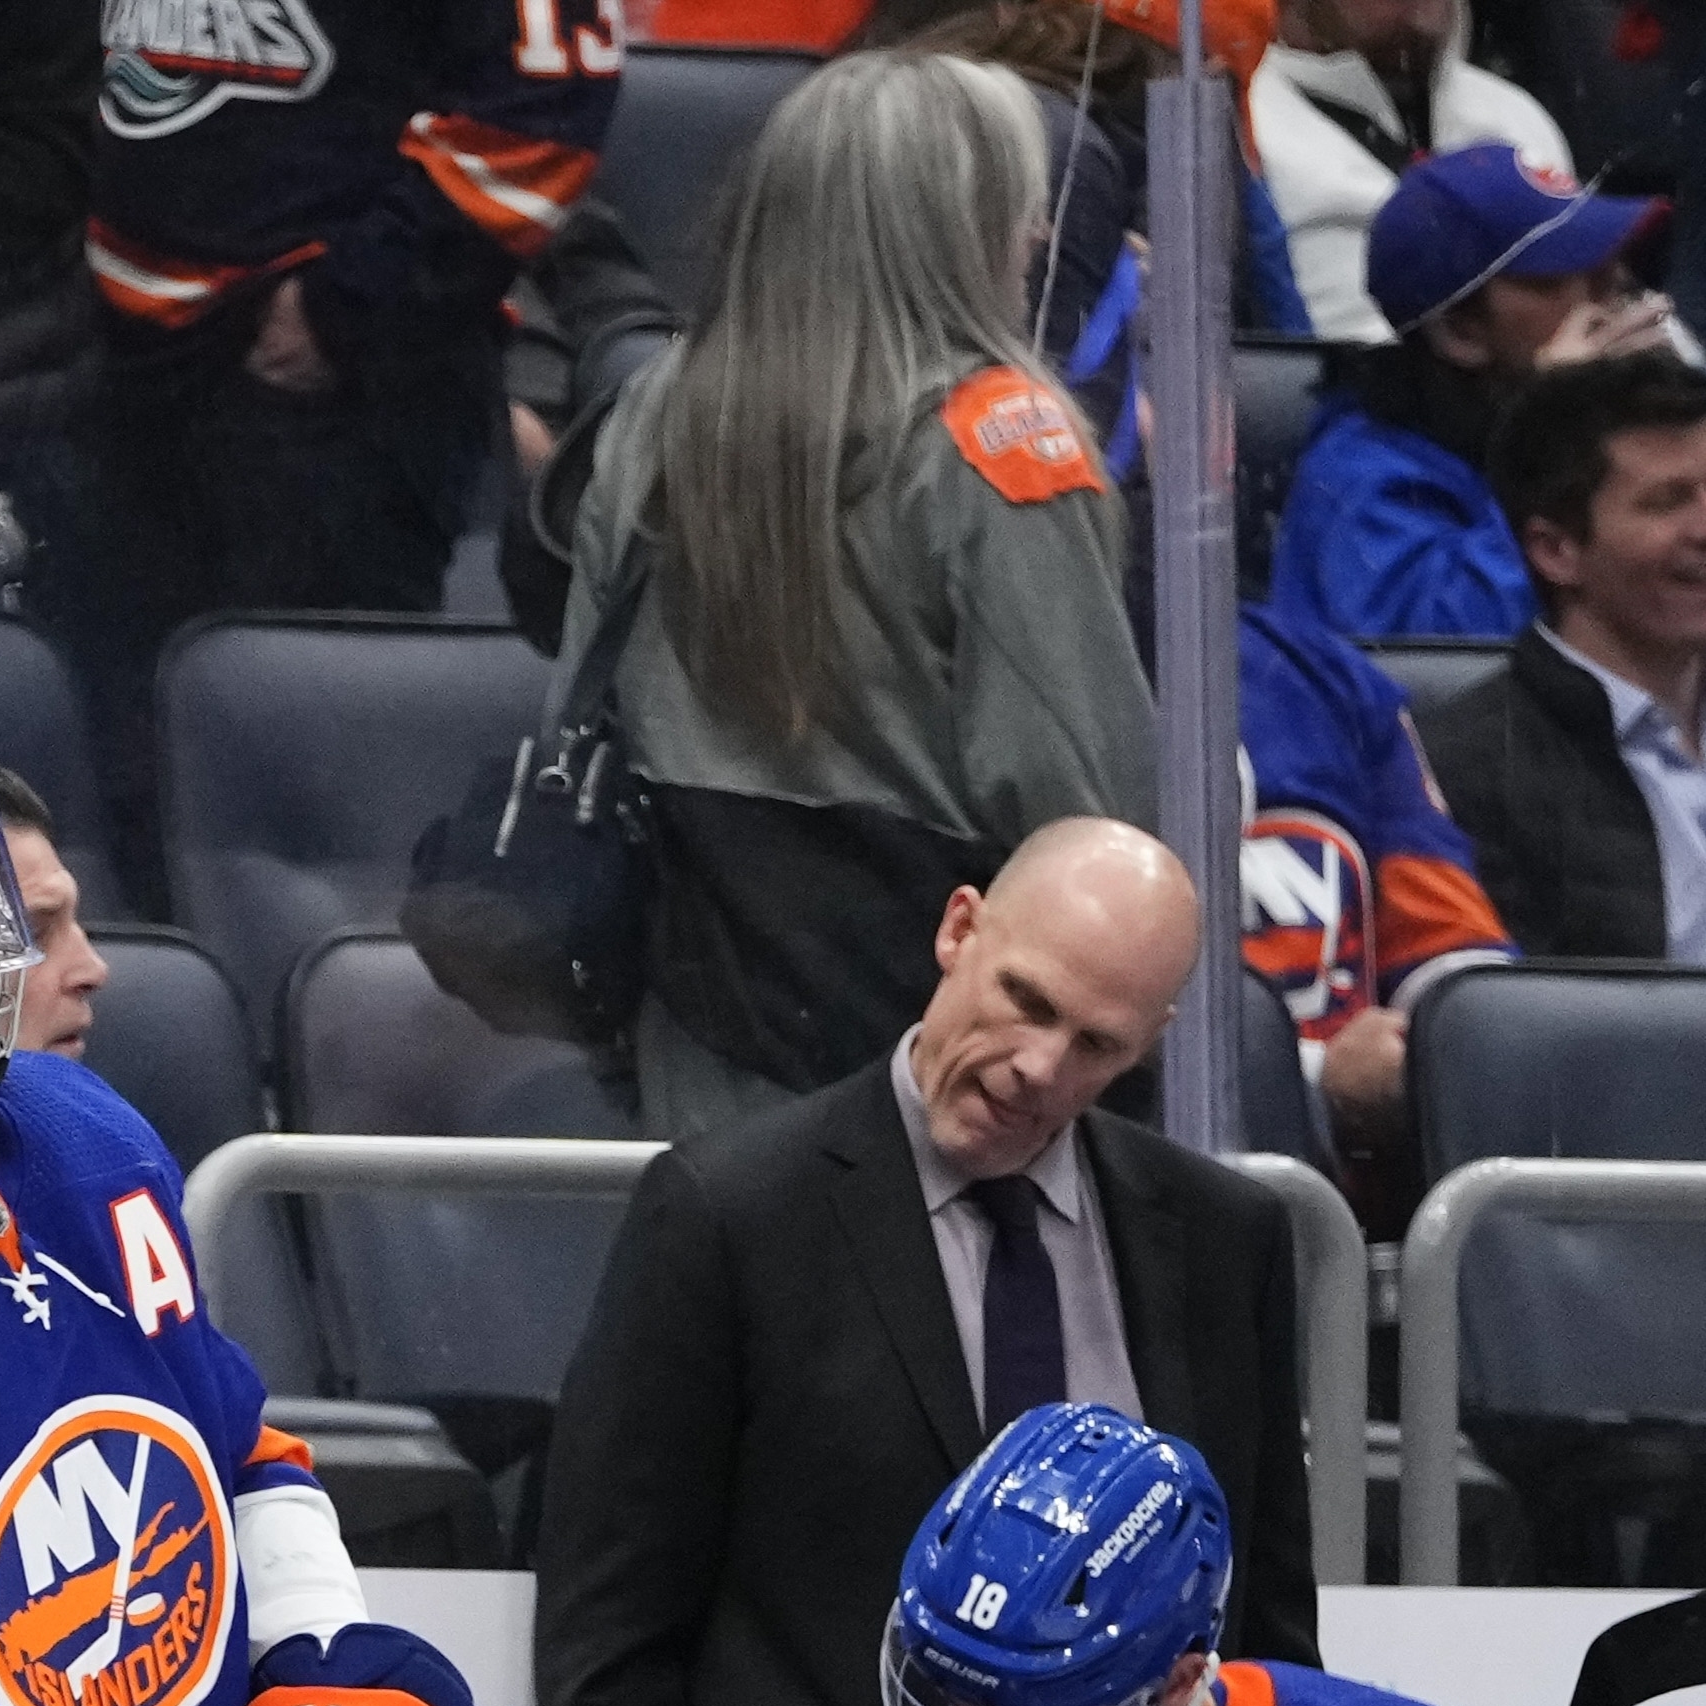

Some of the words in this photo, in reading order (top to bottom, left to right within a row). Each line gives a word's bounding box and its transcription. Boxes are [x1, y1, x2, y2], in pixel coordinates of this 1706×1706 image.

[109, 1187, 196, 1339] A
[12, 1434, 153, 1597] NY
[1084, 1479, 1175, 1579] Jackpocket
[954, 1572, 1009, 1631] 18
